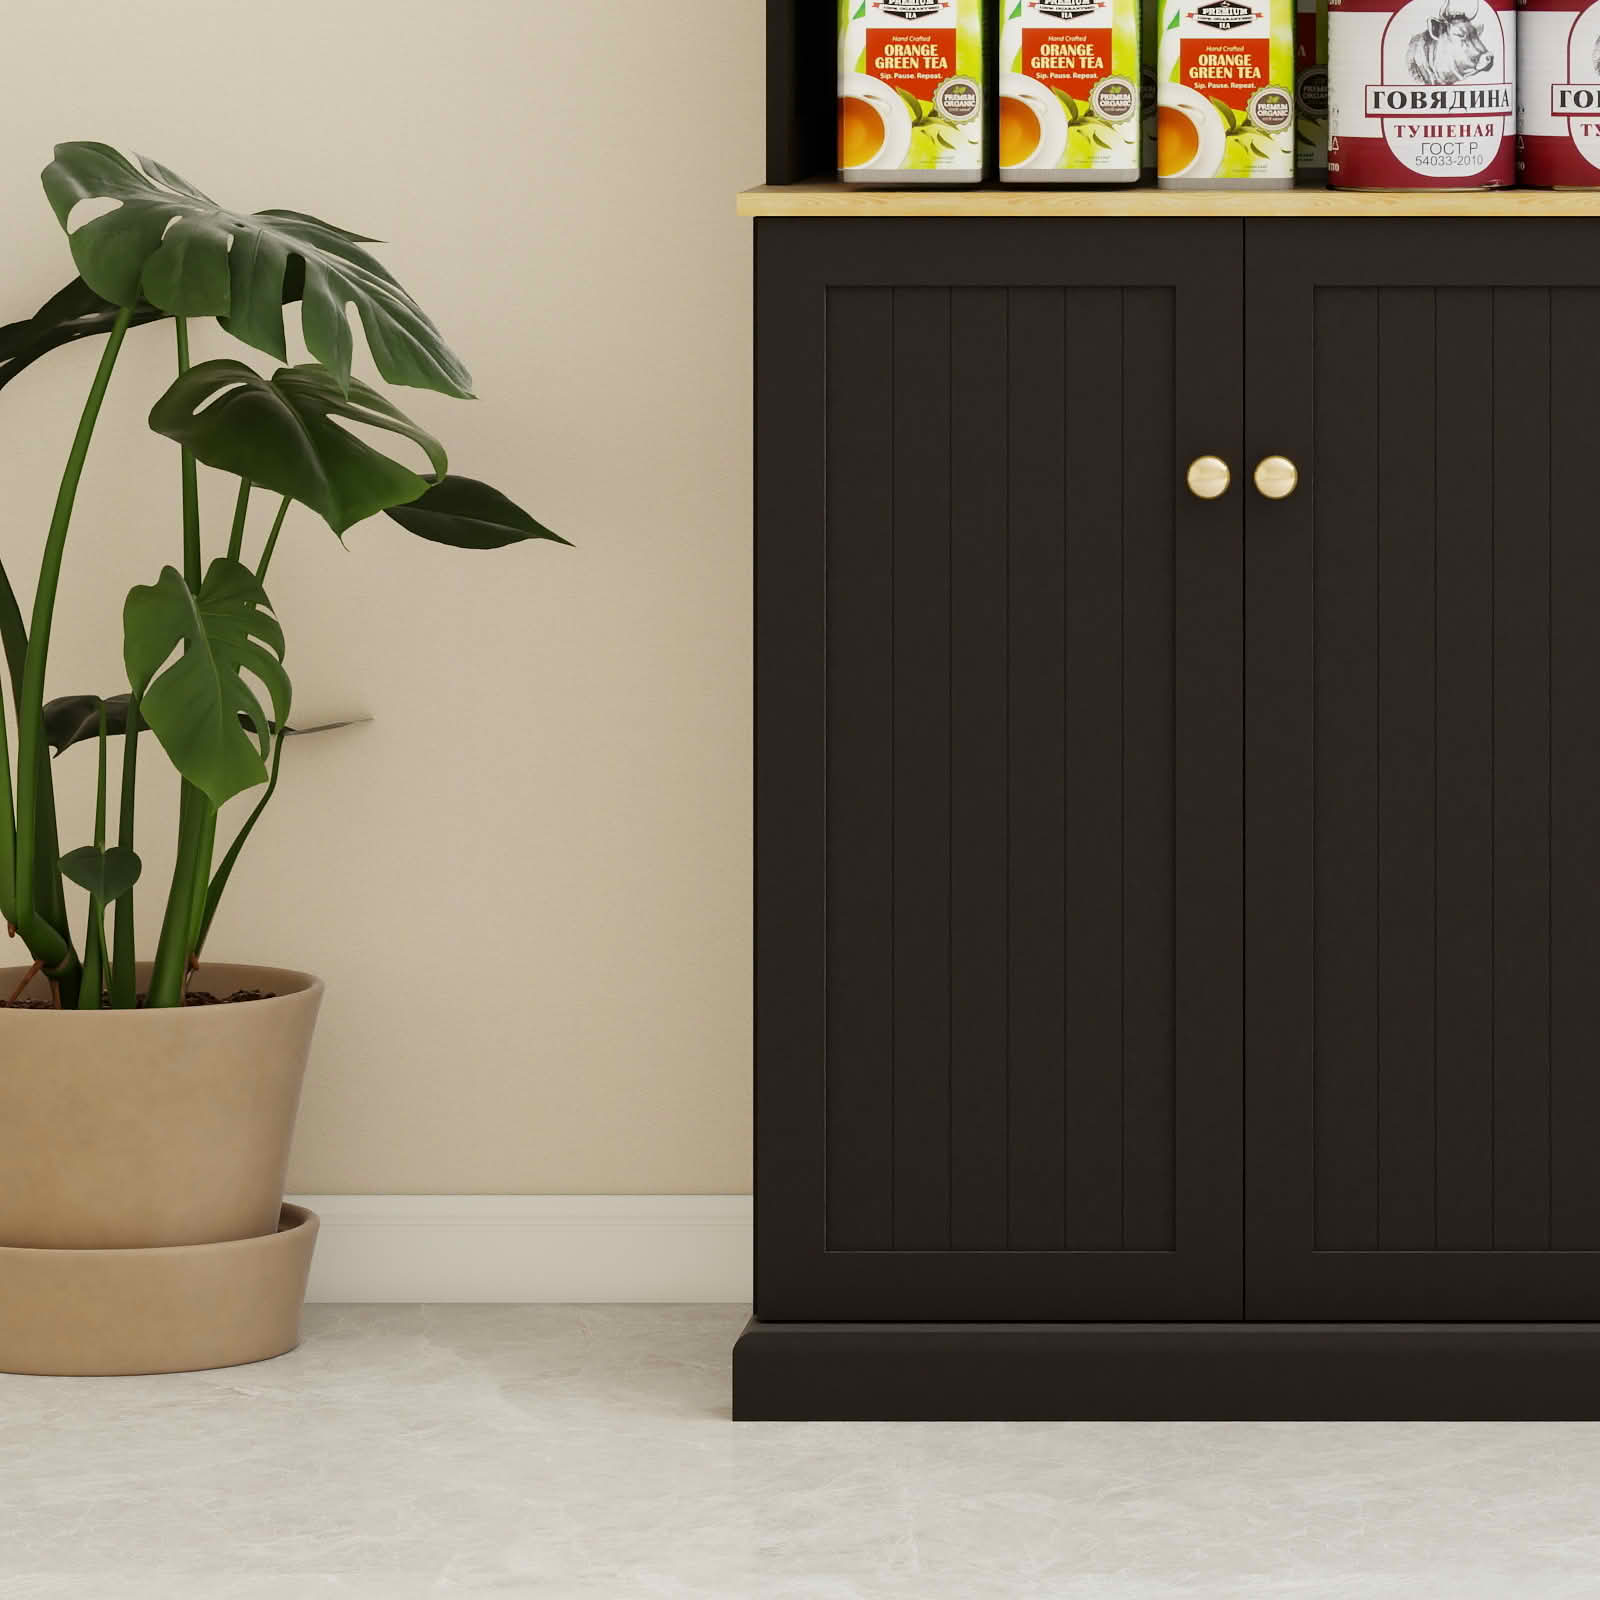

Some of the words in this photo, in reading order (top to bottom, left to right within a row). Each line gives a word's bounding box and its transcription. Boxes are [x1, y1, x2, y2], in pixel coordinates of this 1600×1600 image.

[1202, 7, 1248, 16] PREMIUM
[884, 44, 939, 56] ORANGE
[1040, 44, 1095, 56] ORANGE
[875, 57, 919, 69] GREEN
[923, 57, 948, 69] TEA
[1031, 57, 1075, 69] GREEN
[1079, 57, 1104, 69] TEA
[1198, 54, 1252, 66] ORANGE
[1189, 67, 1233, 79] GREEN
[1236, 67, 1261, 79] TEA
[1373, 90, 1510, 111] ГОВЯДИНА
[1394, 124, 1494, 138] ТУШЕНАЯ
[1421, 142, 1464, 154] ГОСТ
[1469, 141, 1479, 154] Р
[1415, 155, 1484, 166] 54033-2010
